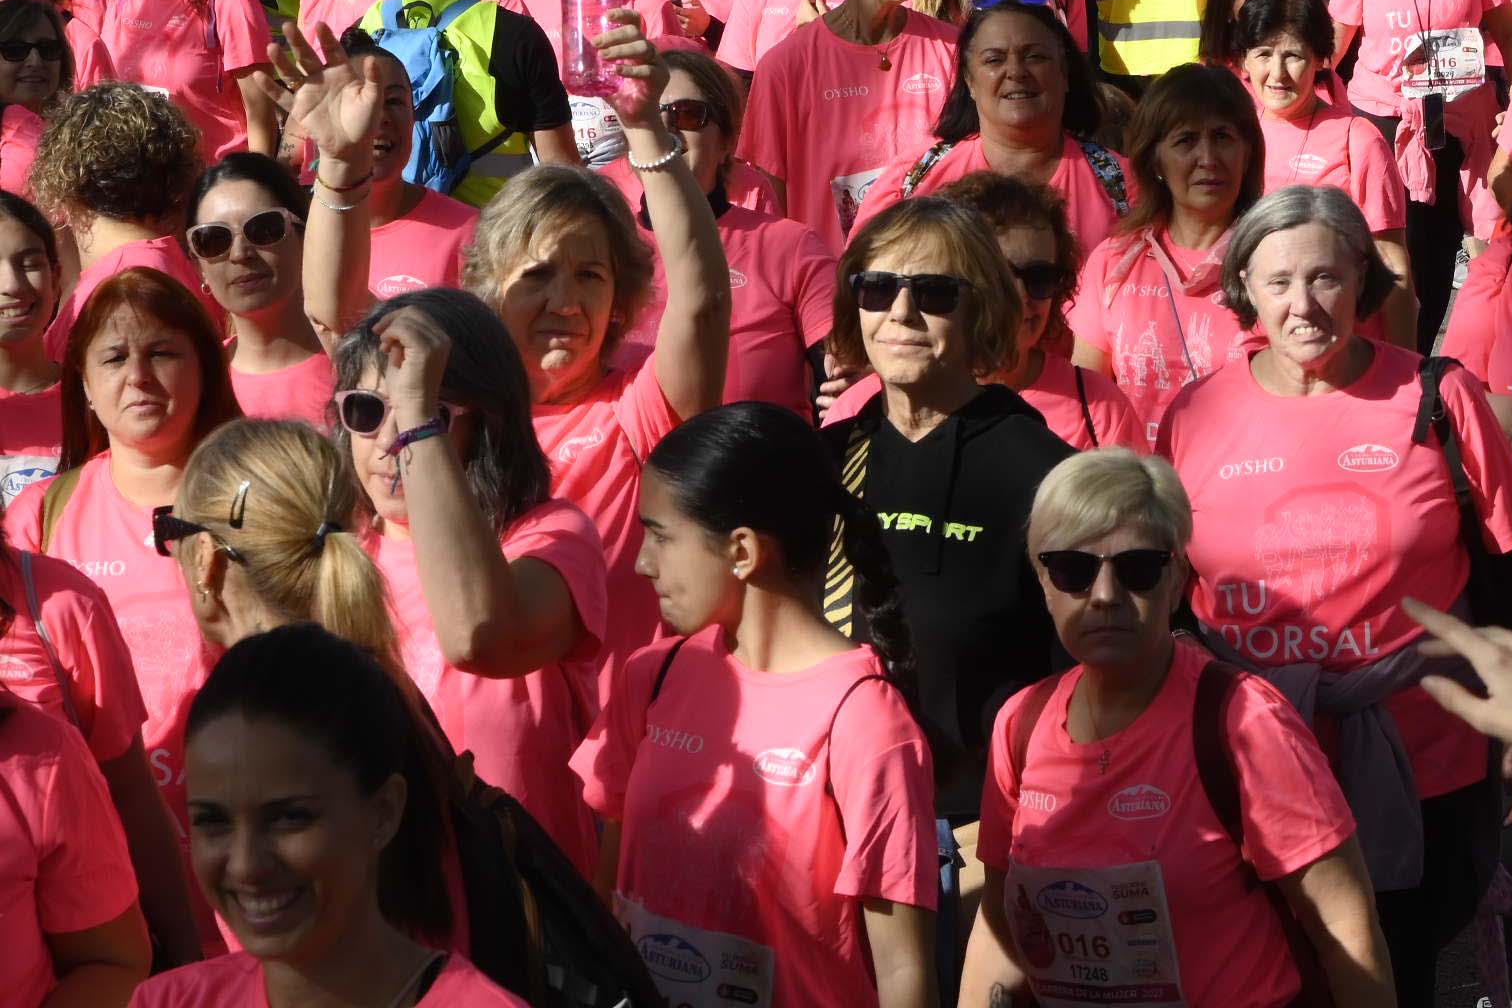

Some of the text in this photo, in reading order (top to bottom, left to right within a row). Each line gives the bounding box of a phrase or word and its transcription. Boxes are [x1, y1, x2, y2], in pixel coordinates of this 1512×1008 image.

[1386, 12, 1412, 28] TU
[824, 85, 869, 100] OYSHO
[579, 128, 598, 140] 16
[1342, 455, 1397, 466] ASTURIANA
[1220, 457, 1286, 481] OYSHO
[877, 512, 984, 542] YSPRT
[1217, 580, 1267, 616] TU
[1110, 798, 1168, 812] ASTURIANA
[1057, 932, 1111, 959] 016
